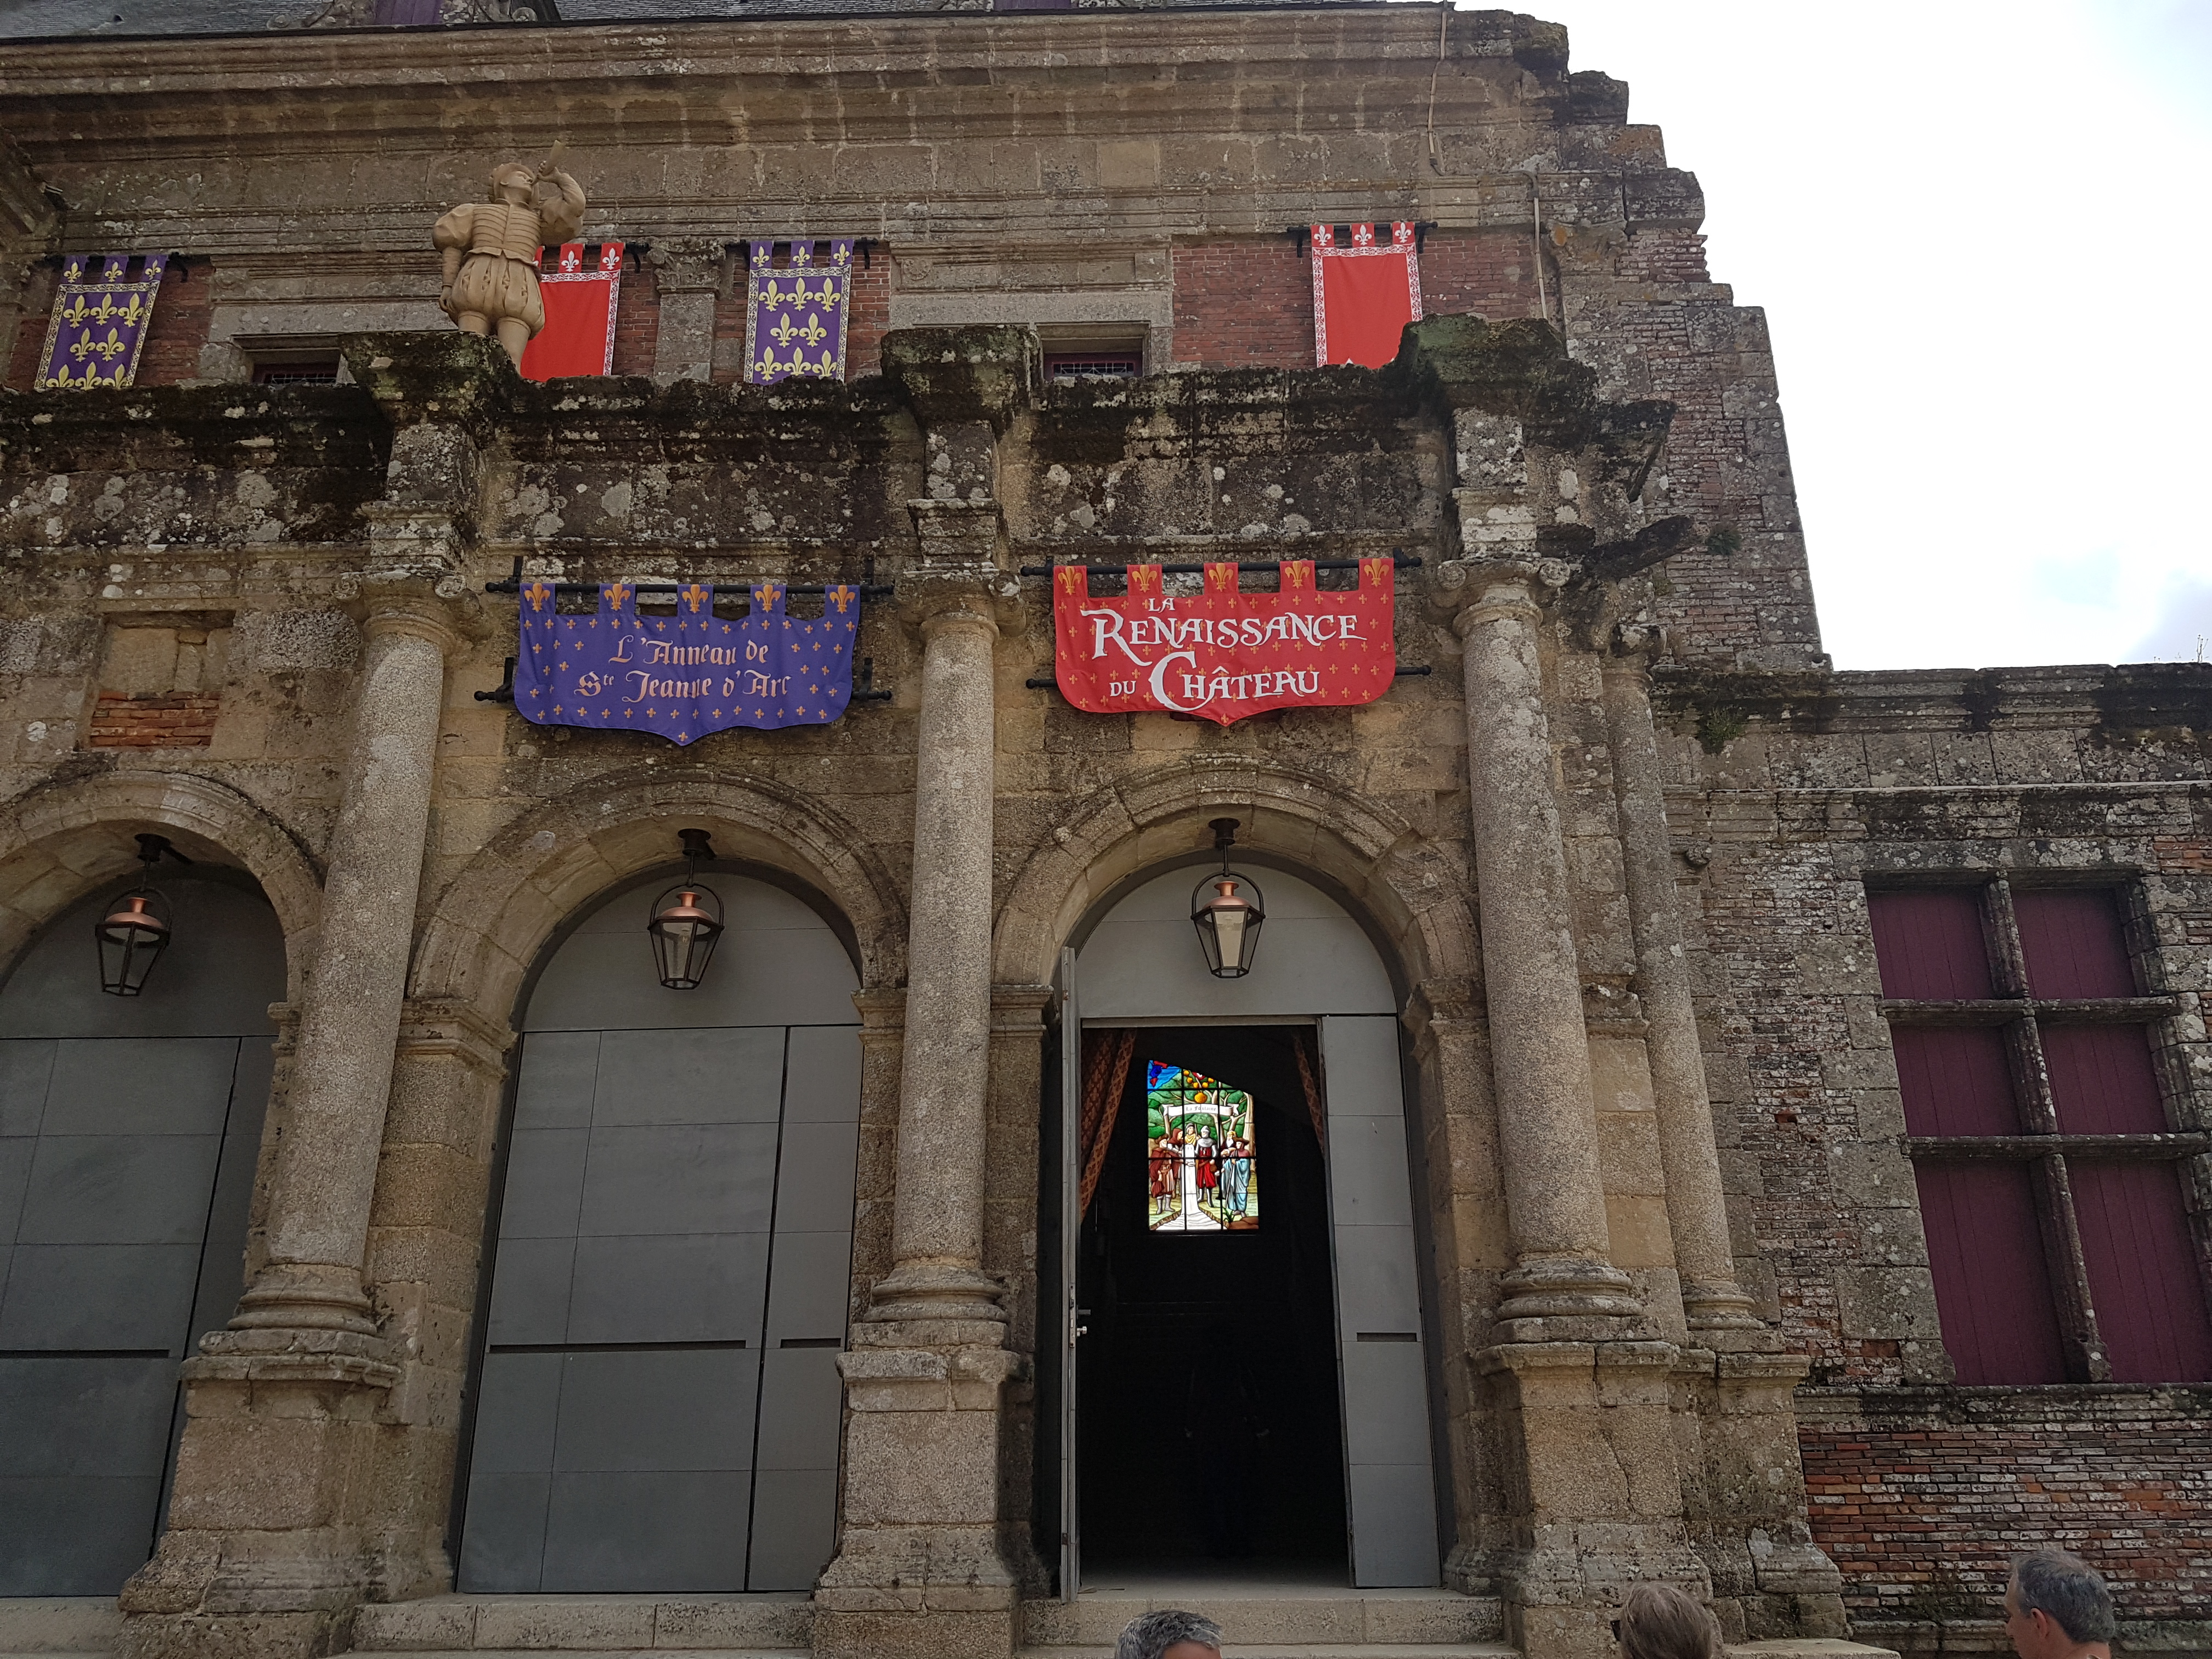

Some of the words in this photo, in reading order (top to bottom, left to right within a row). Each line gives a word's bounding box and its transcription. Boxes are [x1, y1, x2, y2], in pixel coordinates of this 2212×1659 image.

[1148, 598, 1175, 612] LA
[608, 635, 737, 665] L'Anneau
[746, 639, 769, 663] de
[1080, 609, 1368, 666] RENAISSANCE
[622, 670, 712, 703] Jeanne
[723, 669, 792, 698] d'Arc
[1109, 681, 1136, 696] DU
[1148, 651, 1319, 711] CHÂTEAU
